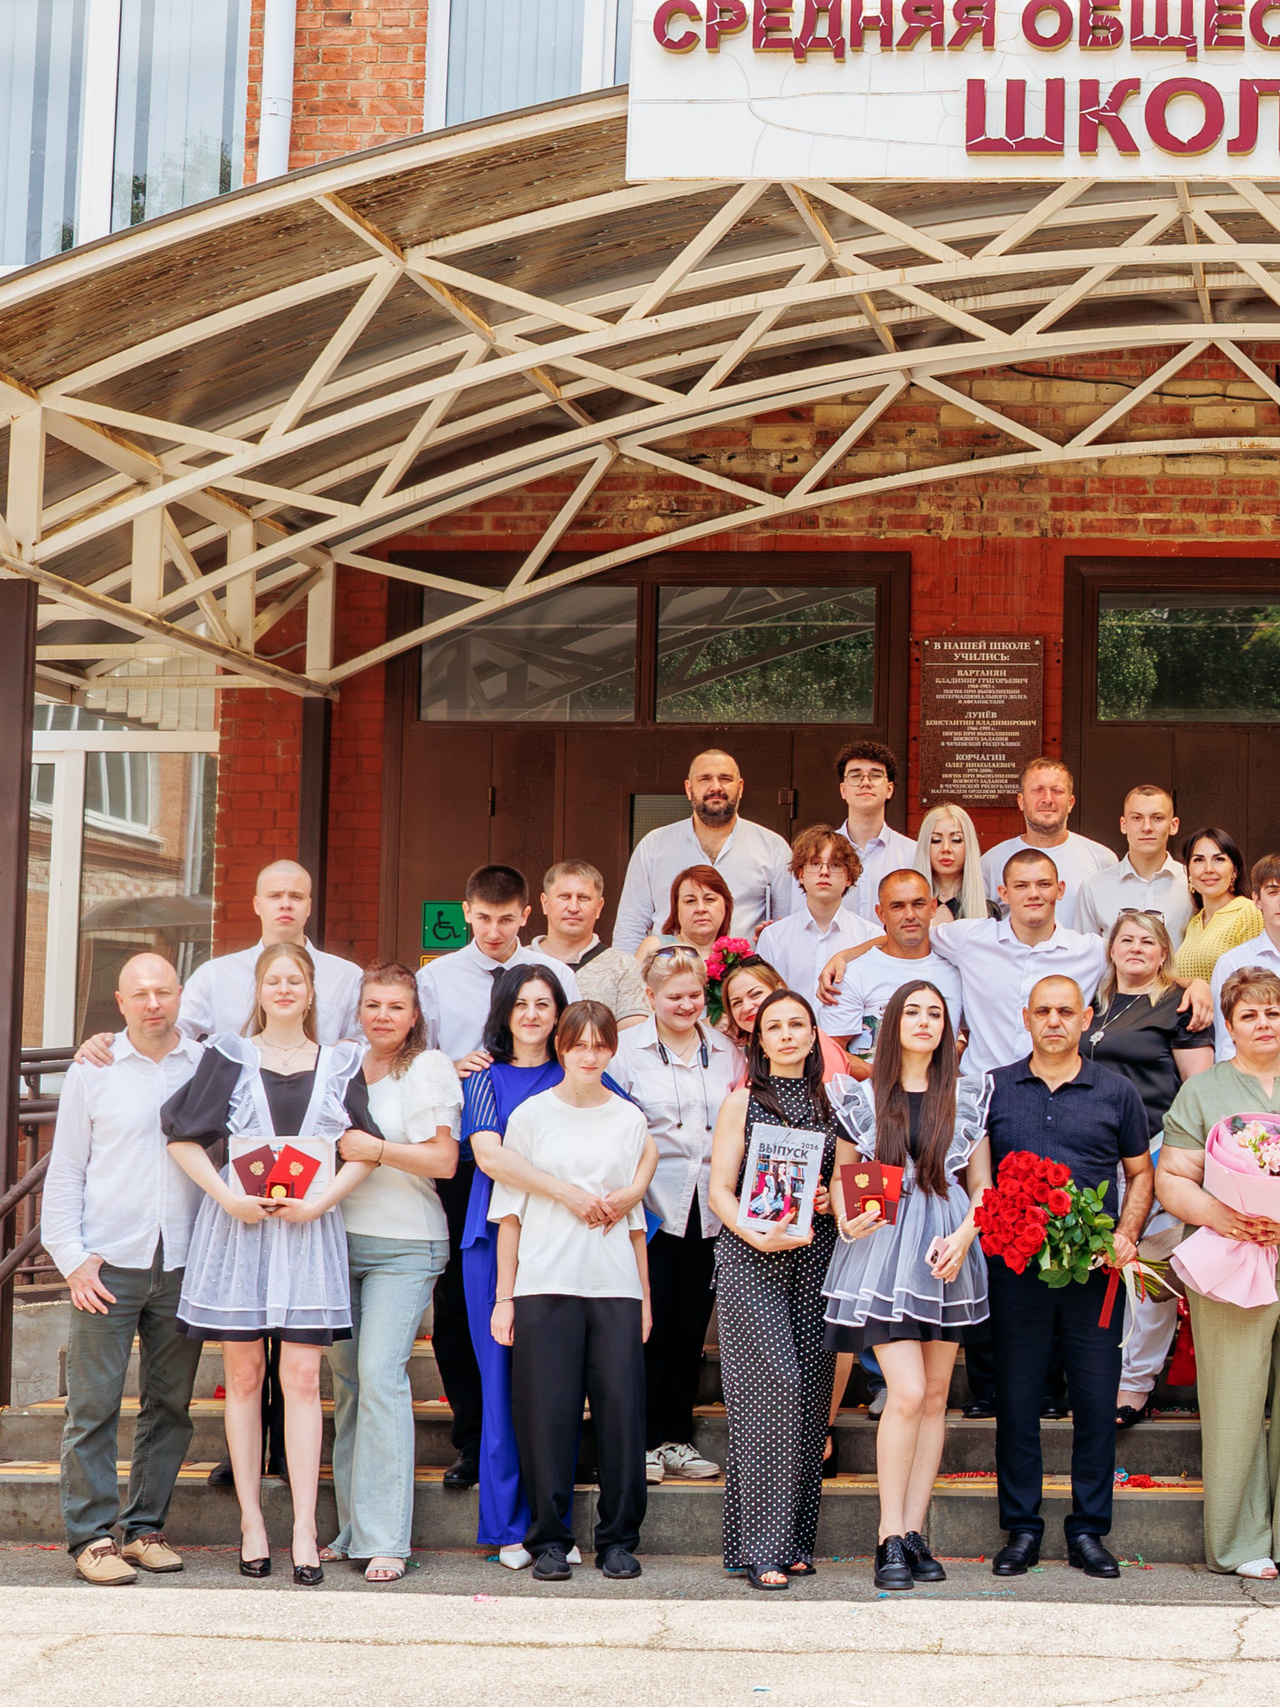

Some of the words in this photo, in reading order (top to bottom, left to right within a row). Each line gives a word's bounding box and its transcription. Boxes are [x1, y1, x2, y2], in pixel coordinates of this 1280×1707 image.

[652, 0, 995, 63] СРЕДНЯЯ
[933, 641, 941, 650] В
[943, 641, 987, 650] НАШЕЙ
[989, 641, 1031, 650] ШКОЛЕ
[953, 652, 1010, 661] УЧИЛИСЬ:
[957, 669, 1007, 677] ВАРТАНЯН
[964, 710, 998, 719] ЛУНЁВ
[955, 753, 1006, 761] КОРЧАГИН
[801, 1141, 819, 1151] 2026
[759, 1142, 809, 1160] ВЫПУСК
